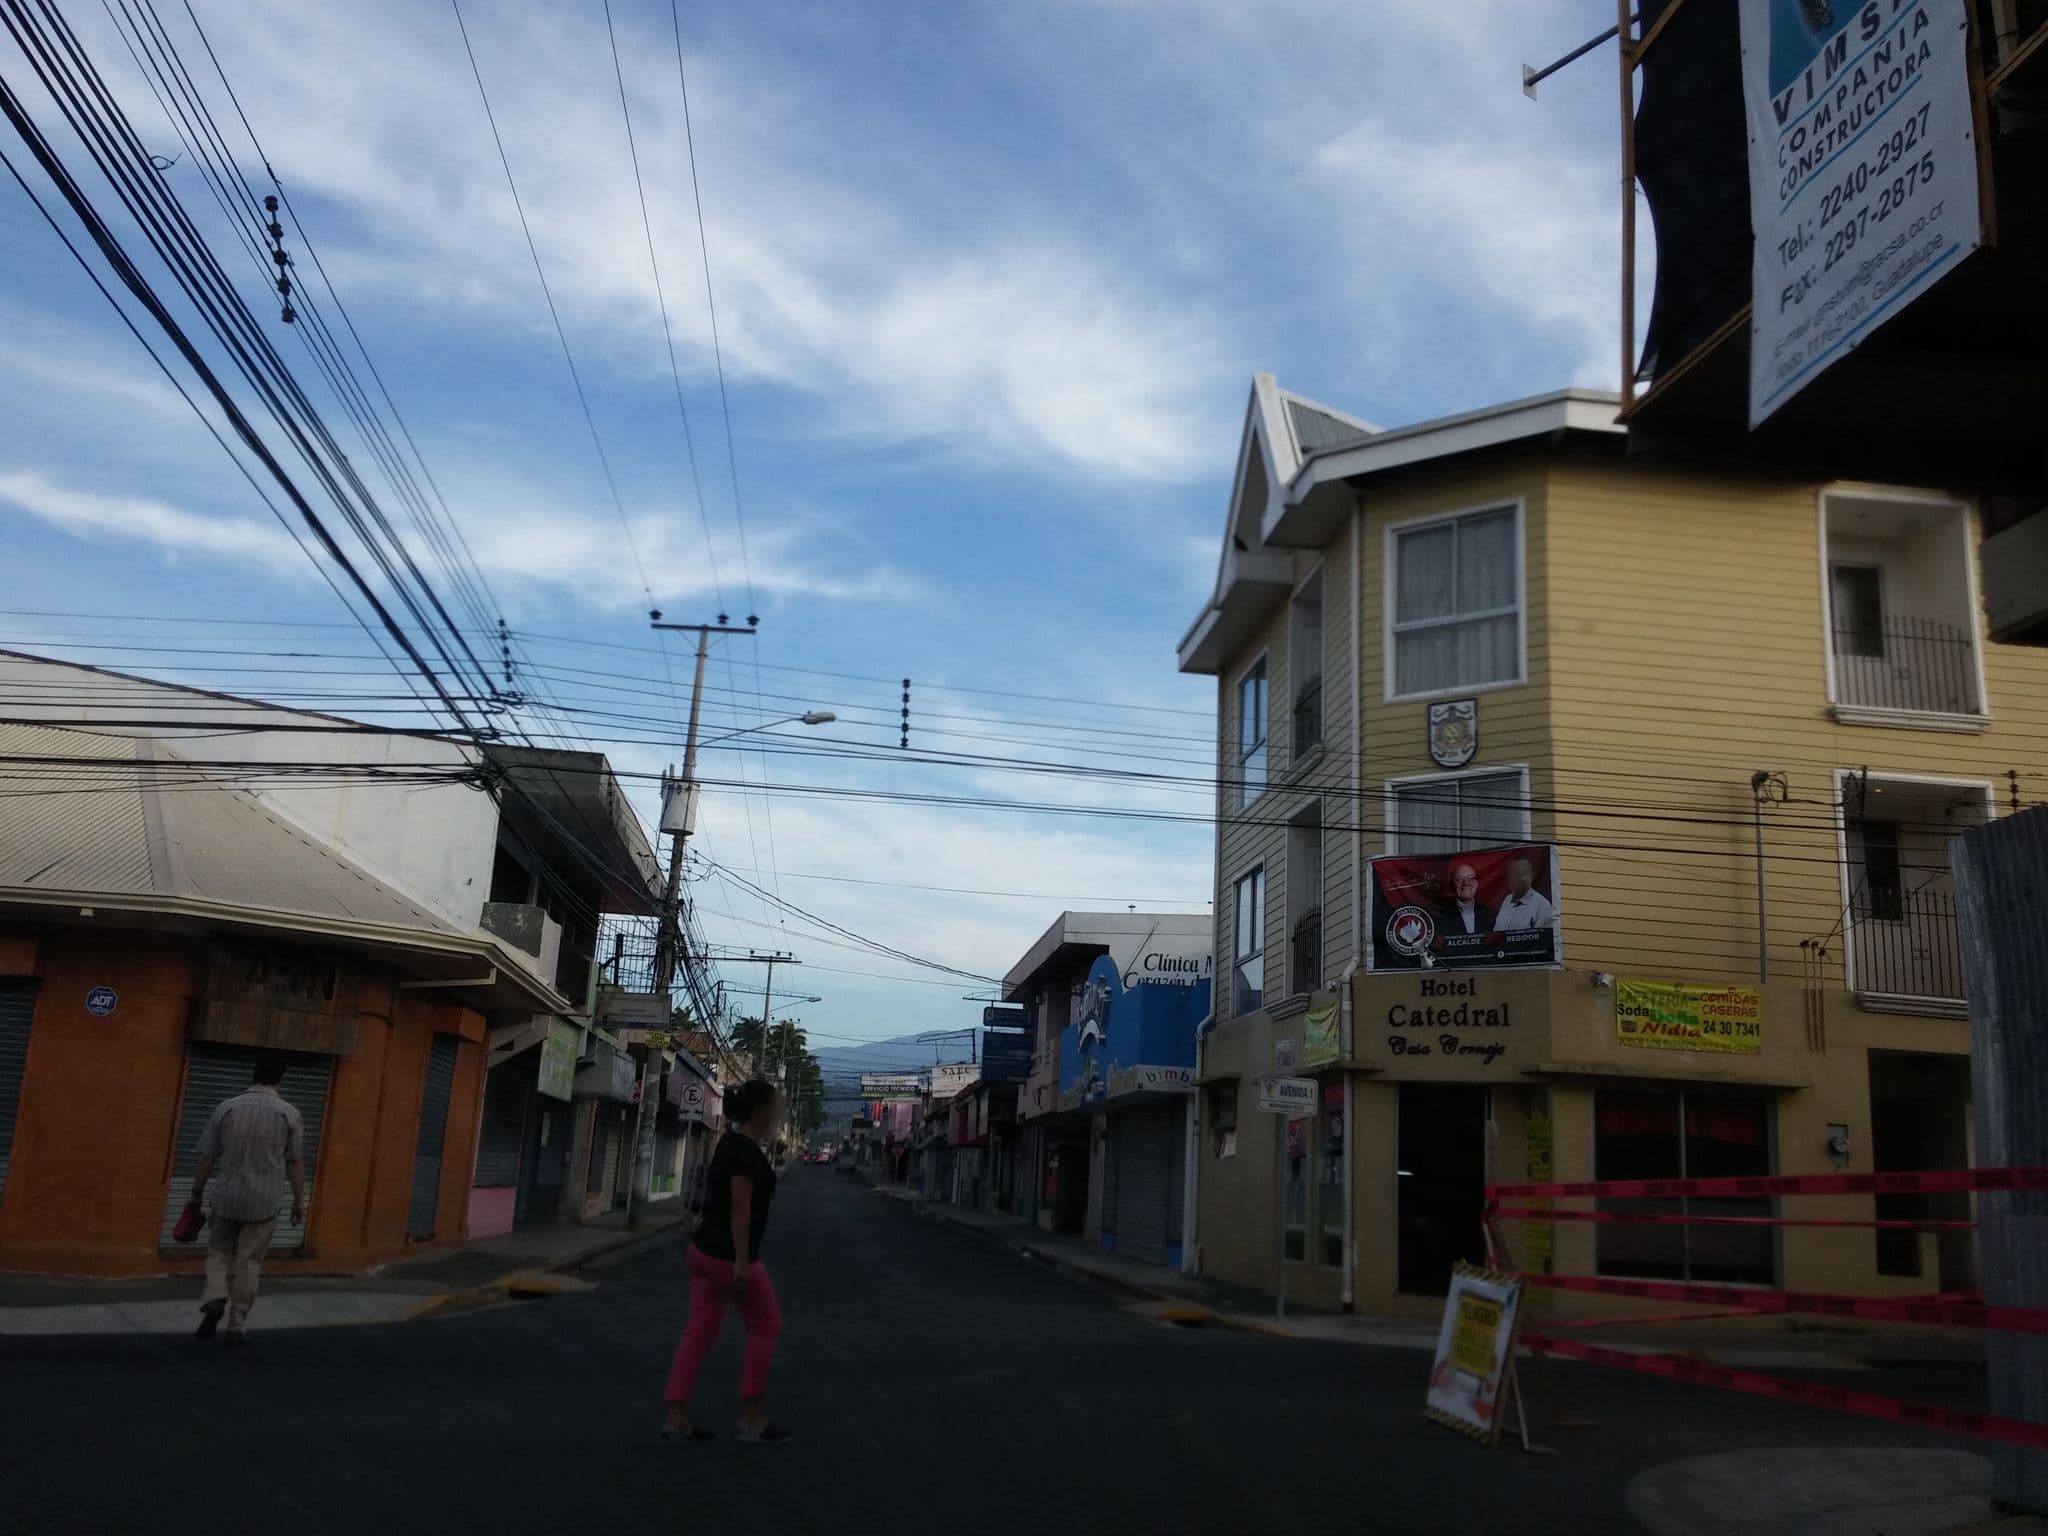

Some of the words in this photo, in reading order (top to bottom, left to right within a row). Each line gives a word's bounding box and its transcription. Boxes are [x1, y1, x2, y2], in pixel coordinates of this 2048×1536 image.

[1772, 0, 1900, 126] VIMS
[1779, 39, 1931, 201] CONSTRUCTORA
[1819, 101, 1931, 229] 2240-2927
[1824, 149, 1935, 272] 2297-2875
[1447, 937, 1481, 947] ALCALDE
[1506, 933, 1539, 943] REGIDOR
[1143, 953, 1198, 974] Clínica
[1420, 977, 1477, 997] Hotel
[89, 994, 114, 1007] ADT
[1699, 991, 1759, 1006] COMIDAS
[1388, 1002, 1511, 1027] Catedral
[1616, 1003, 1650, 1017] Soda
[1701, 1004, 1758, 1018] CASERAS
[1640, 1022, 1702, 1038] Nidia
[1703, 1020, 1716, 1034] 24
[1719, 1021, 1732, 1035] 30
[1388, 1035, 1432, 1055] Casa
[1438, 1034, 1507, 1065] Cornejo
[1279, 1084, 1308, 1098] AVENIDA
